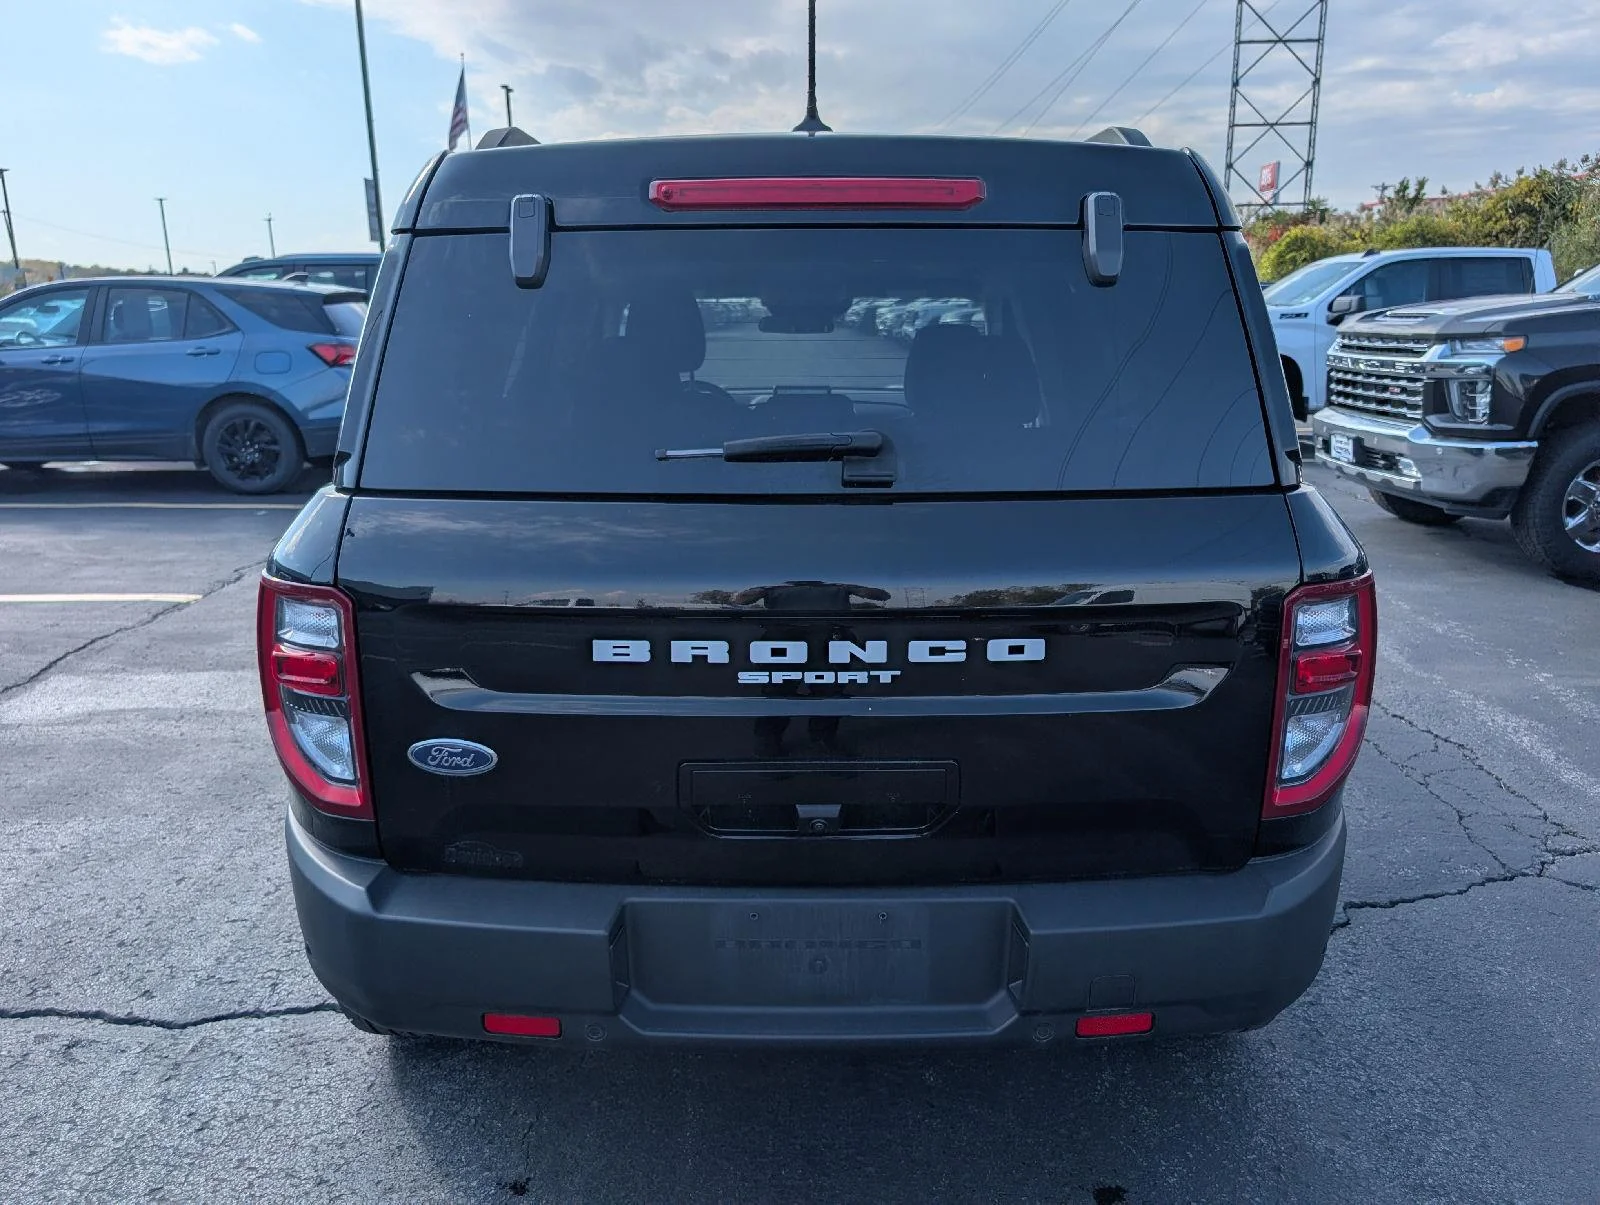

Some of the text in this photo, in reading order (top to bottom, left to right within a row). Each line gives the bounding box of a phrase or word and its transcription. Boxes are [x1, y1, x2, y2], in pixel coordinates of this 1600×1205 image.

[592, 638, 1046, 663] BRONCO
[737, 670, 901, 684] SPORT
[427, 746, 475, 767] Ford
